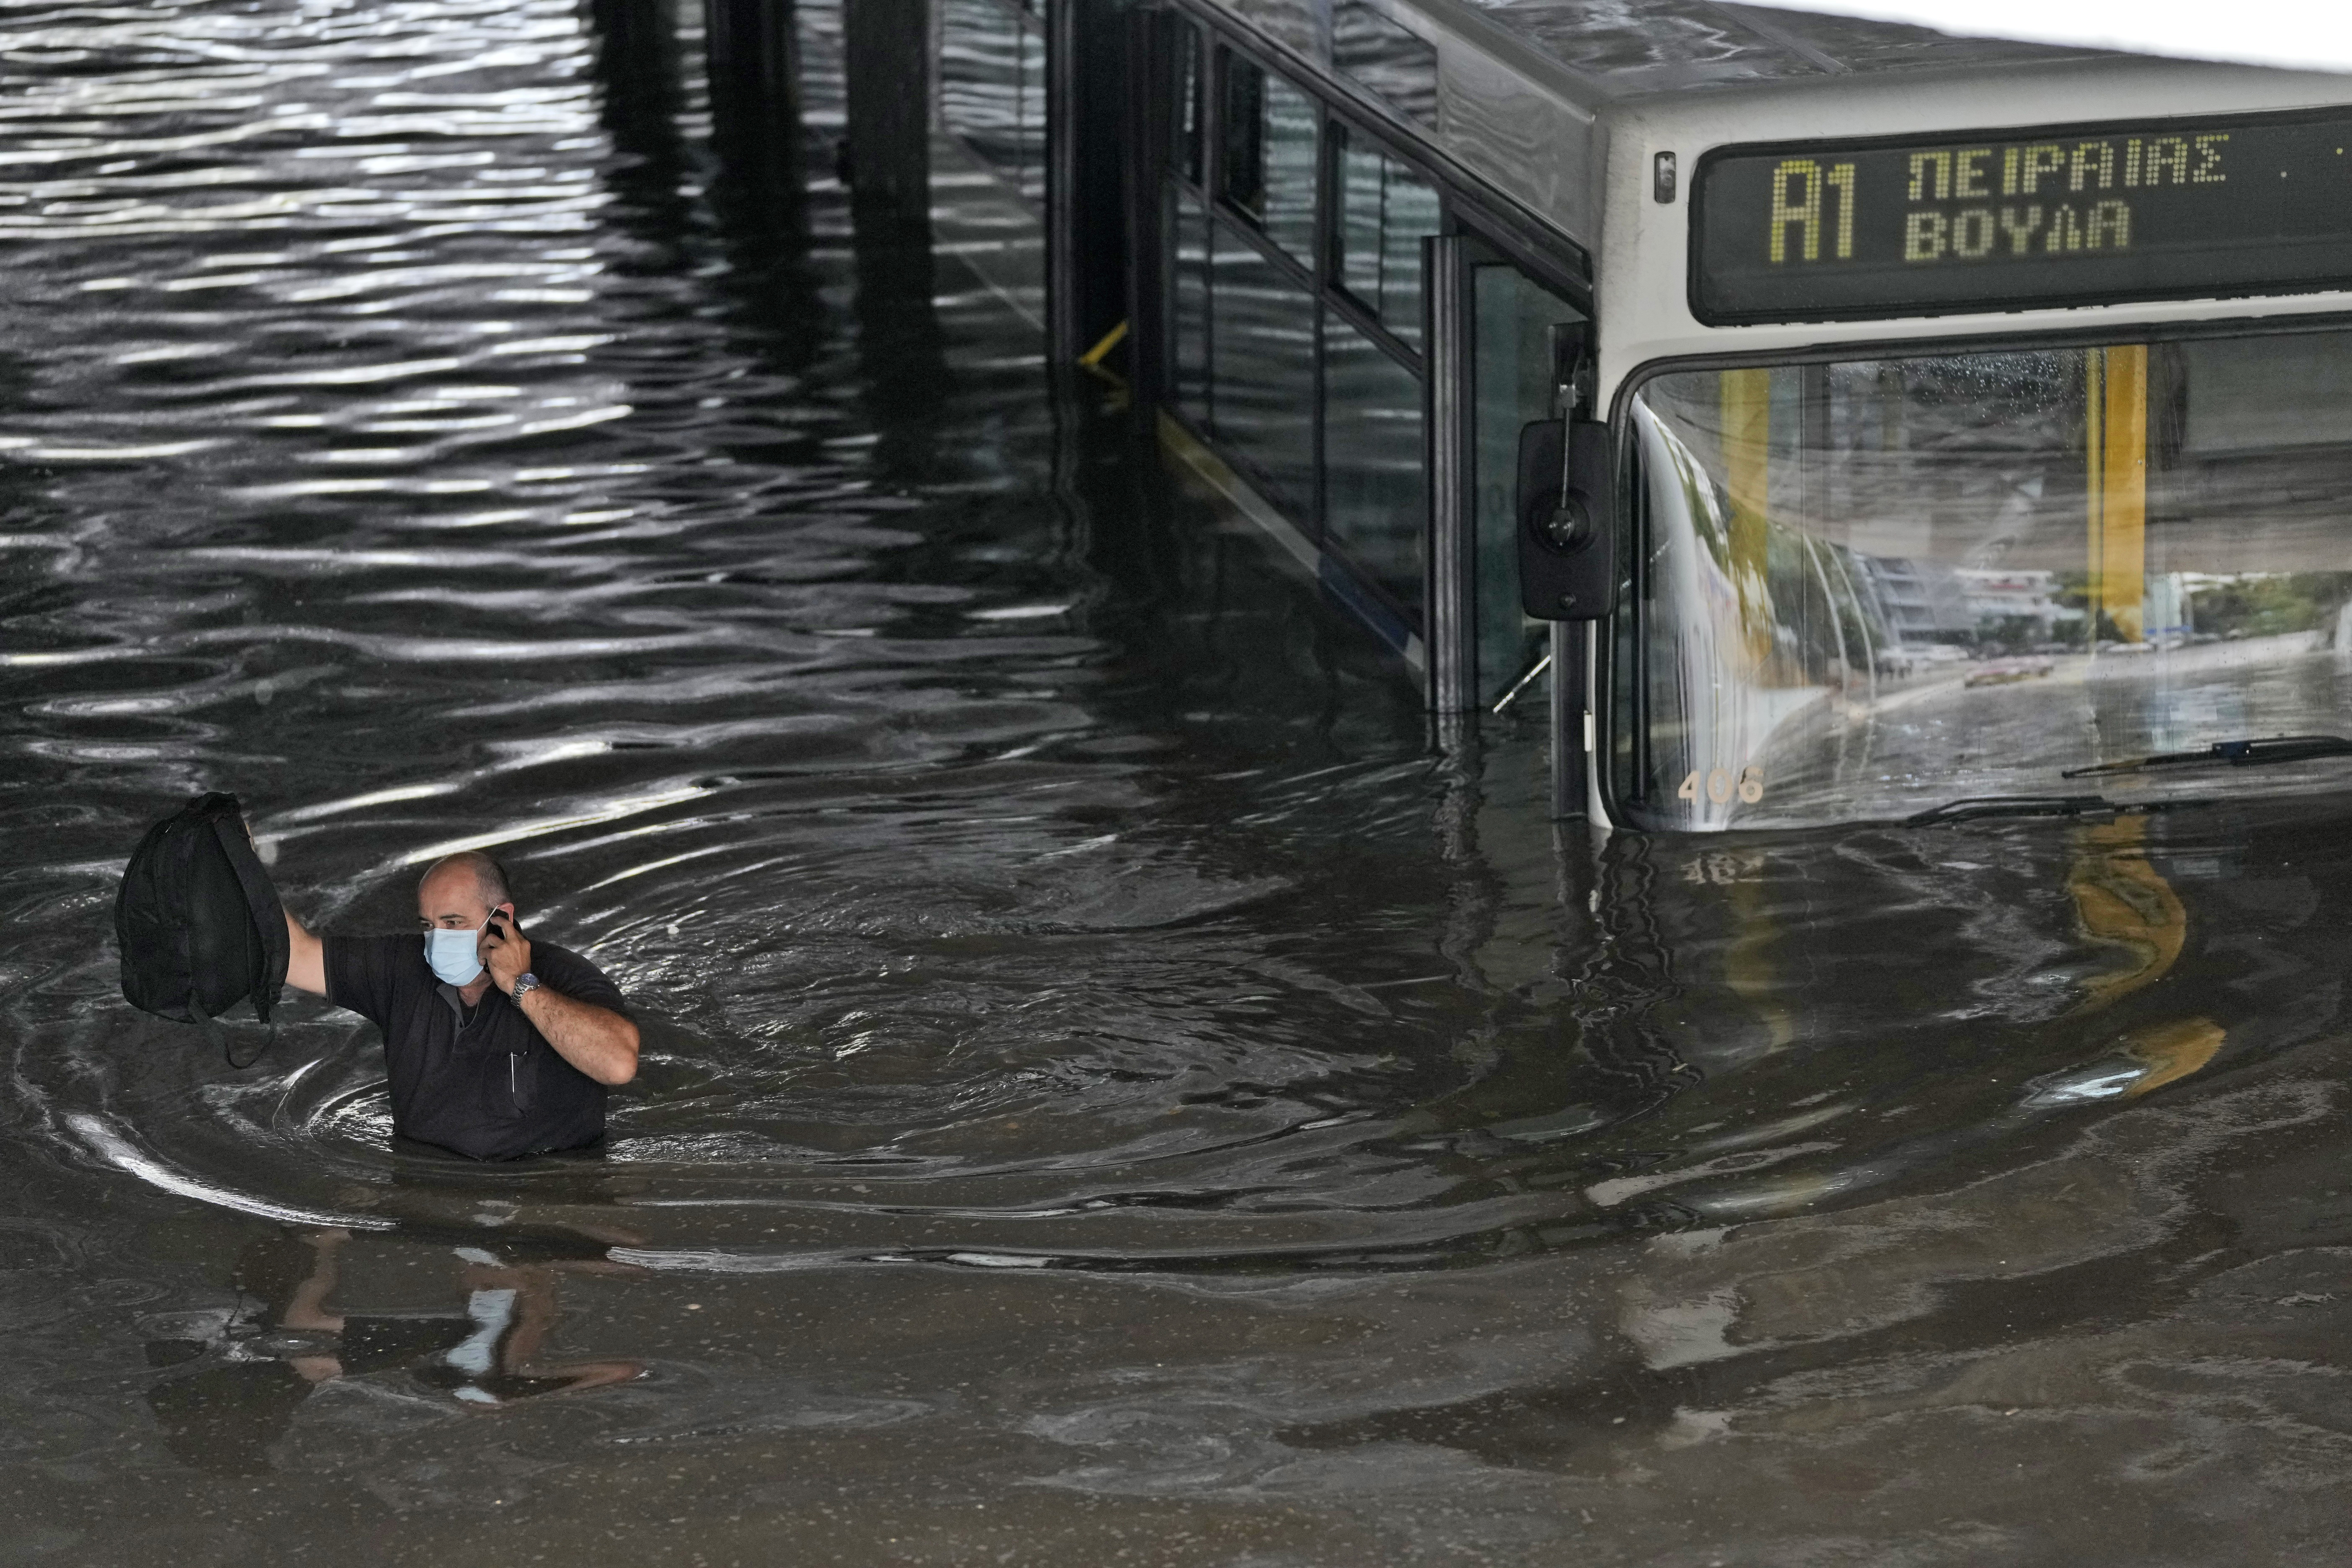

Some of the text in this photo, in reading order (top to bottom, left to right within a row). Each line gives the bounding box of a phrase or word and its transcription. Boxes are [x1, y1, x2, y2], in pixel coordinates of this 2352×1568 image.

[1908, 134, 2229, 200] ΠΕΙΡΑΙΑΣ
[1905, 201, 2131, 260] ΒΟΥΛΑ
[1678, 766, 1764, 805] 406
